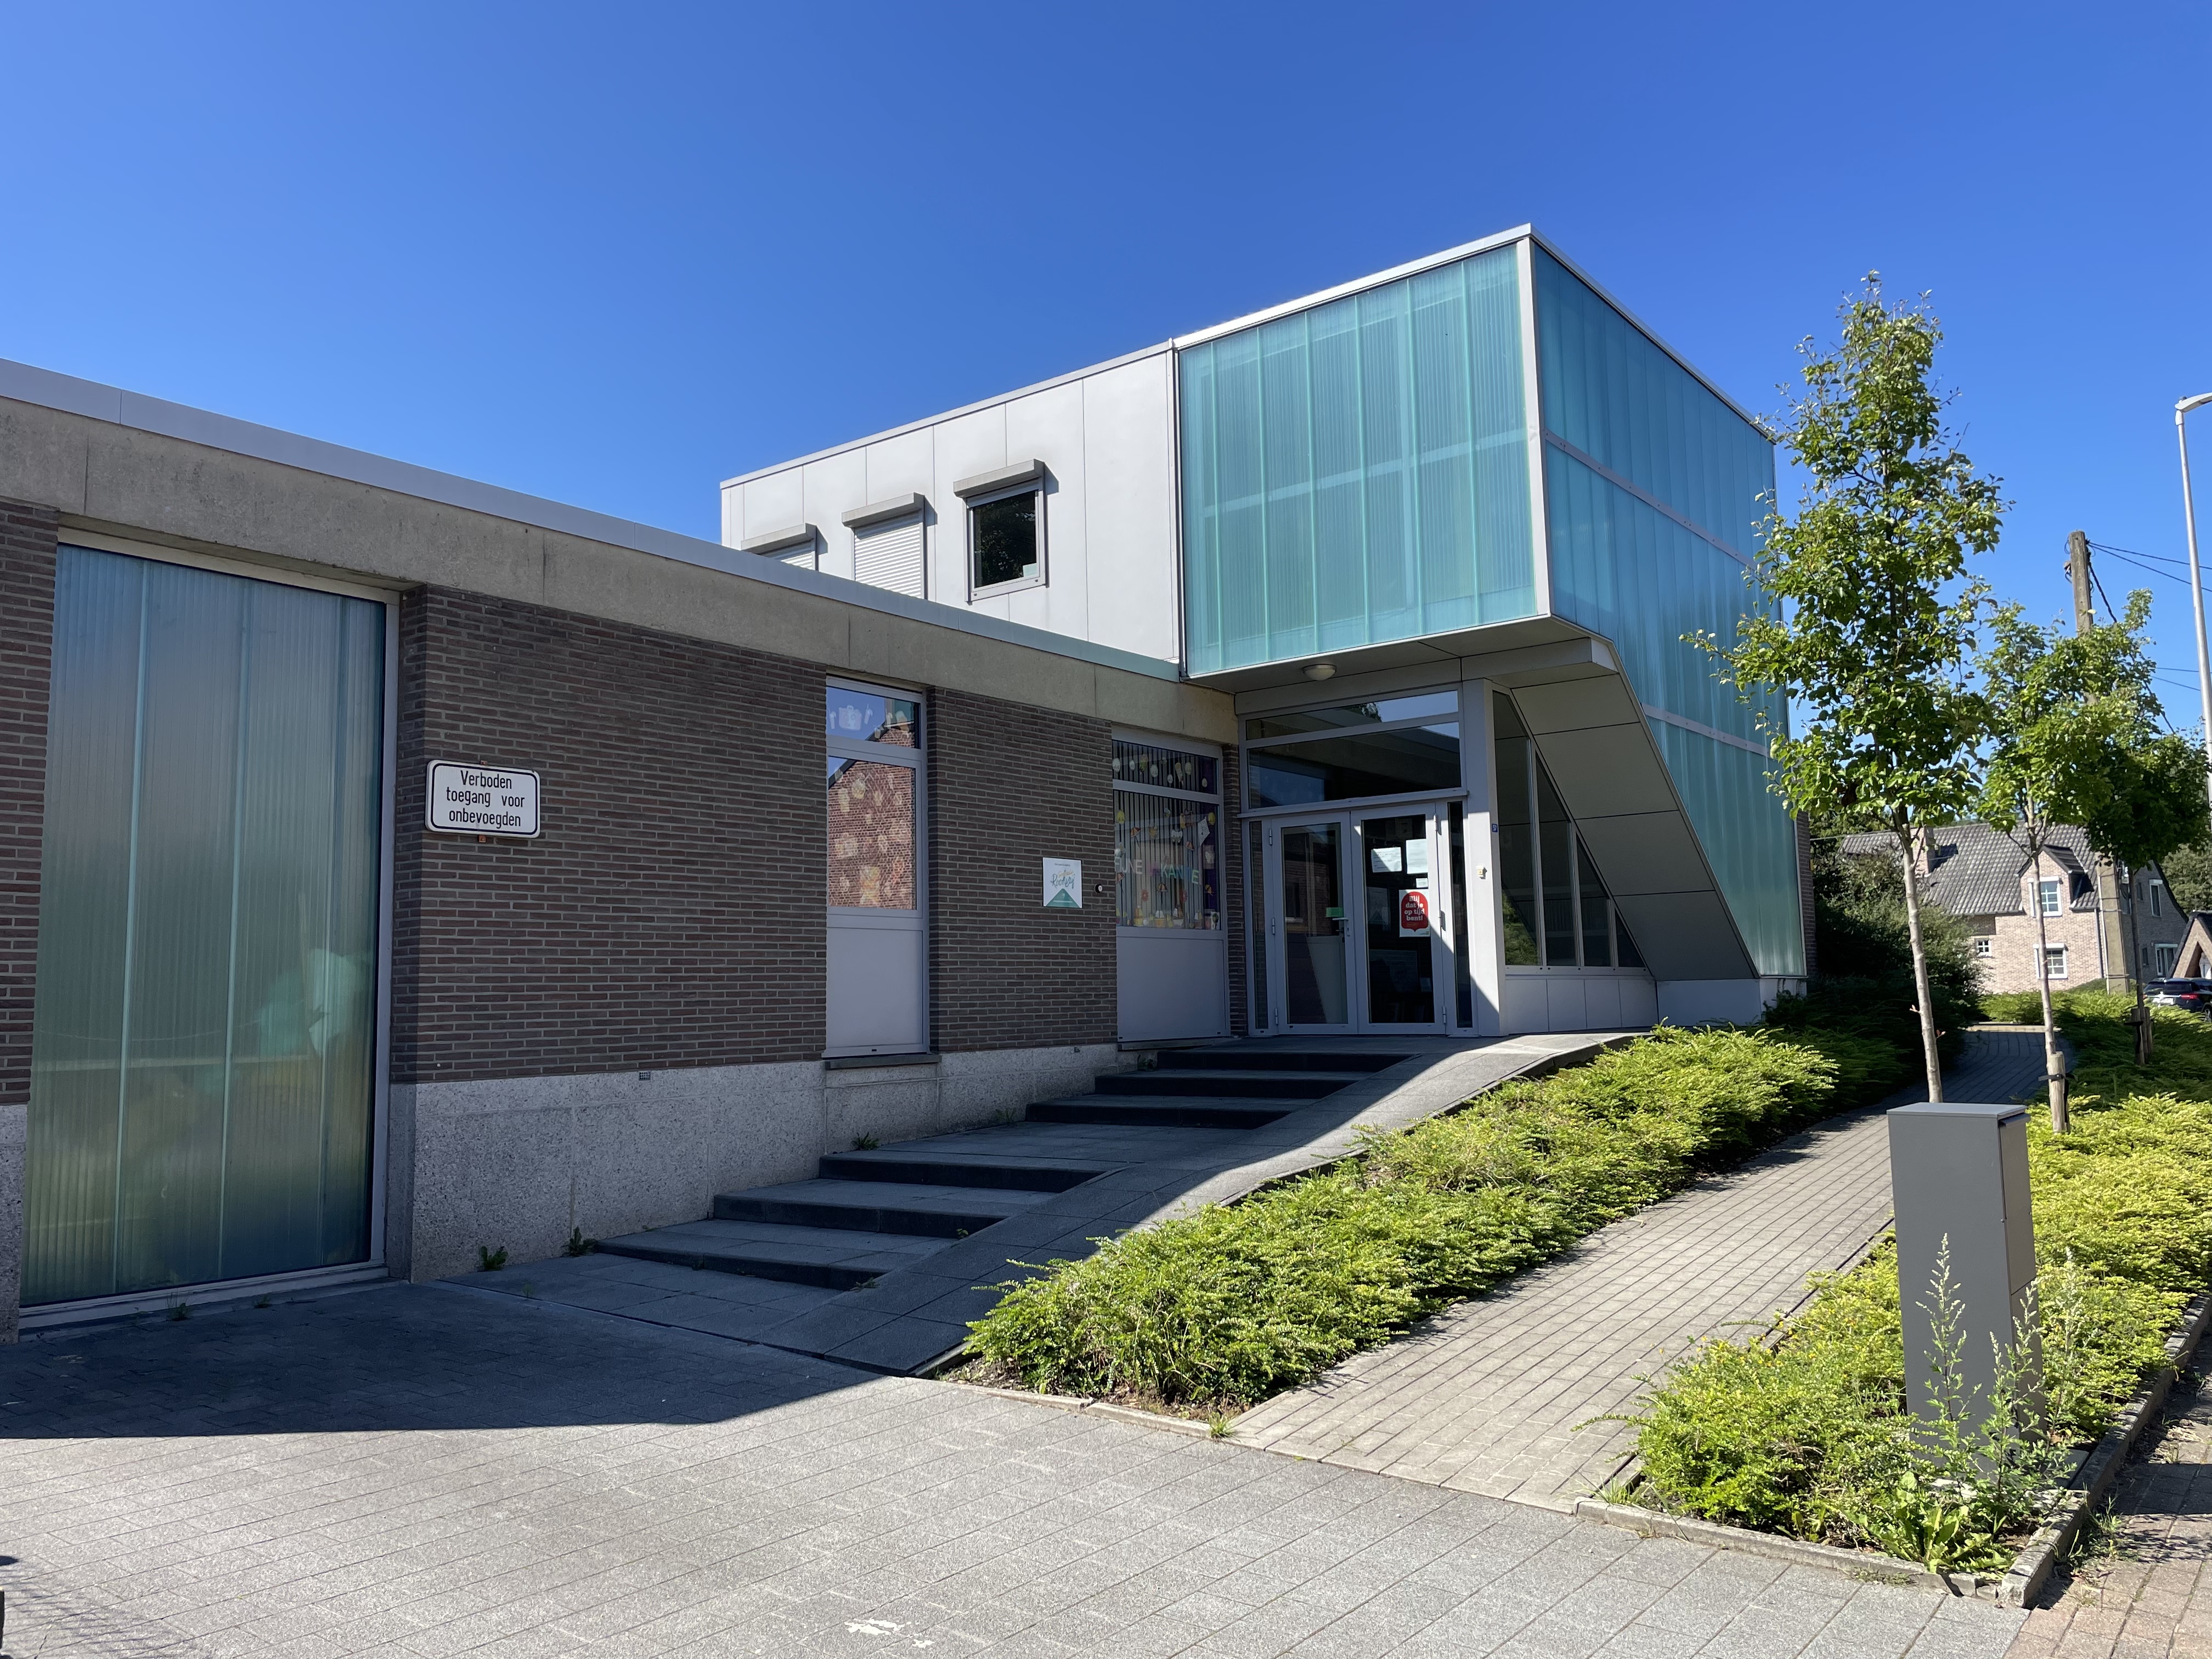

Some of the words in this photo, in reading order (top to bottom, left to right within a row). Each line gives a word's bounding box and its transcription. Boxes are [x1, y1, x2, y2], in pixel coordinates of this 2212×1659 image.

[460, 770, 512, 789] Verboden
[446, 787, 490, 807] toegang
[501, 795, 525, 808] voor
[449, 808, 521, 829] onbevoegden
